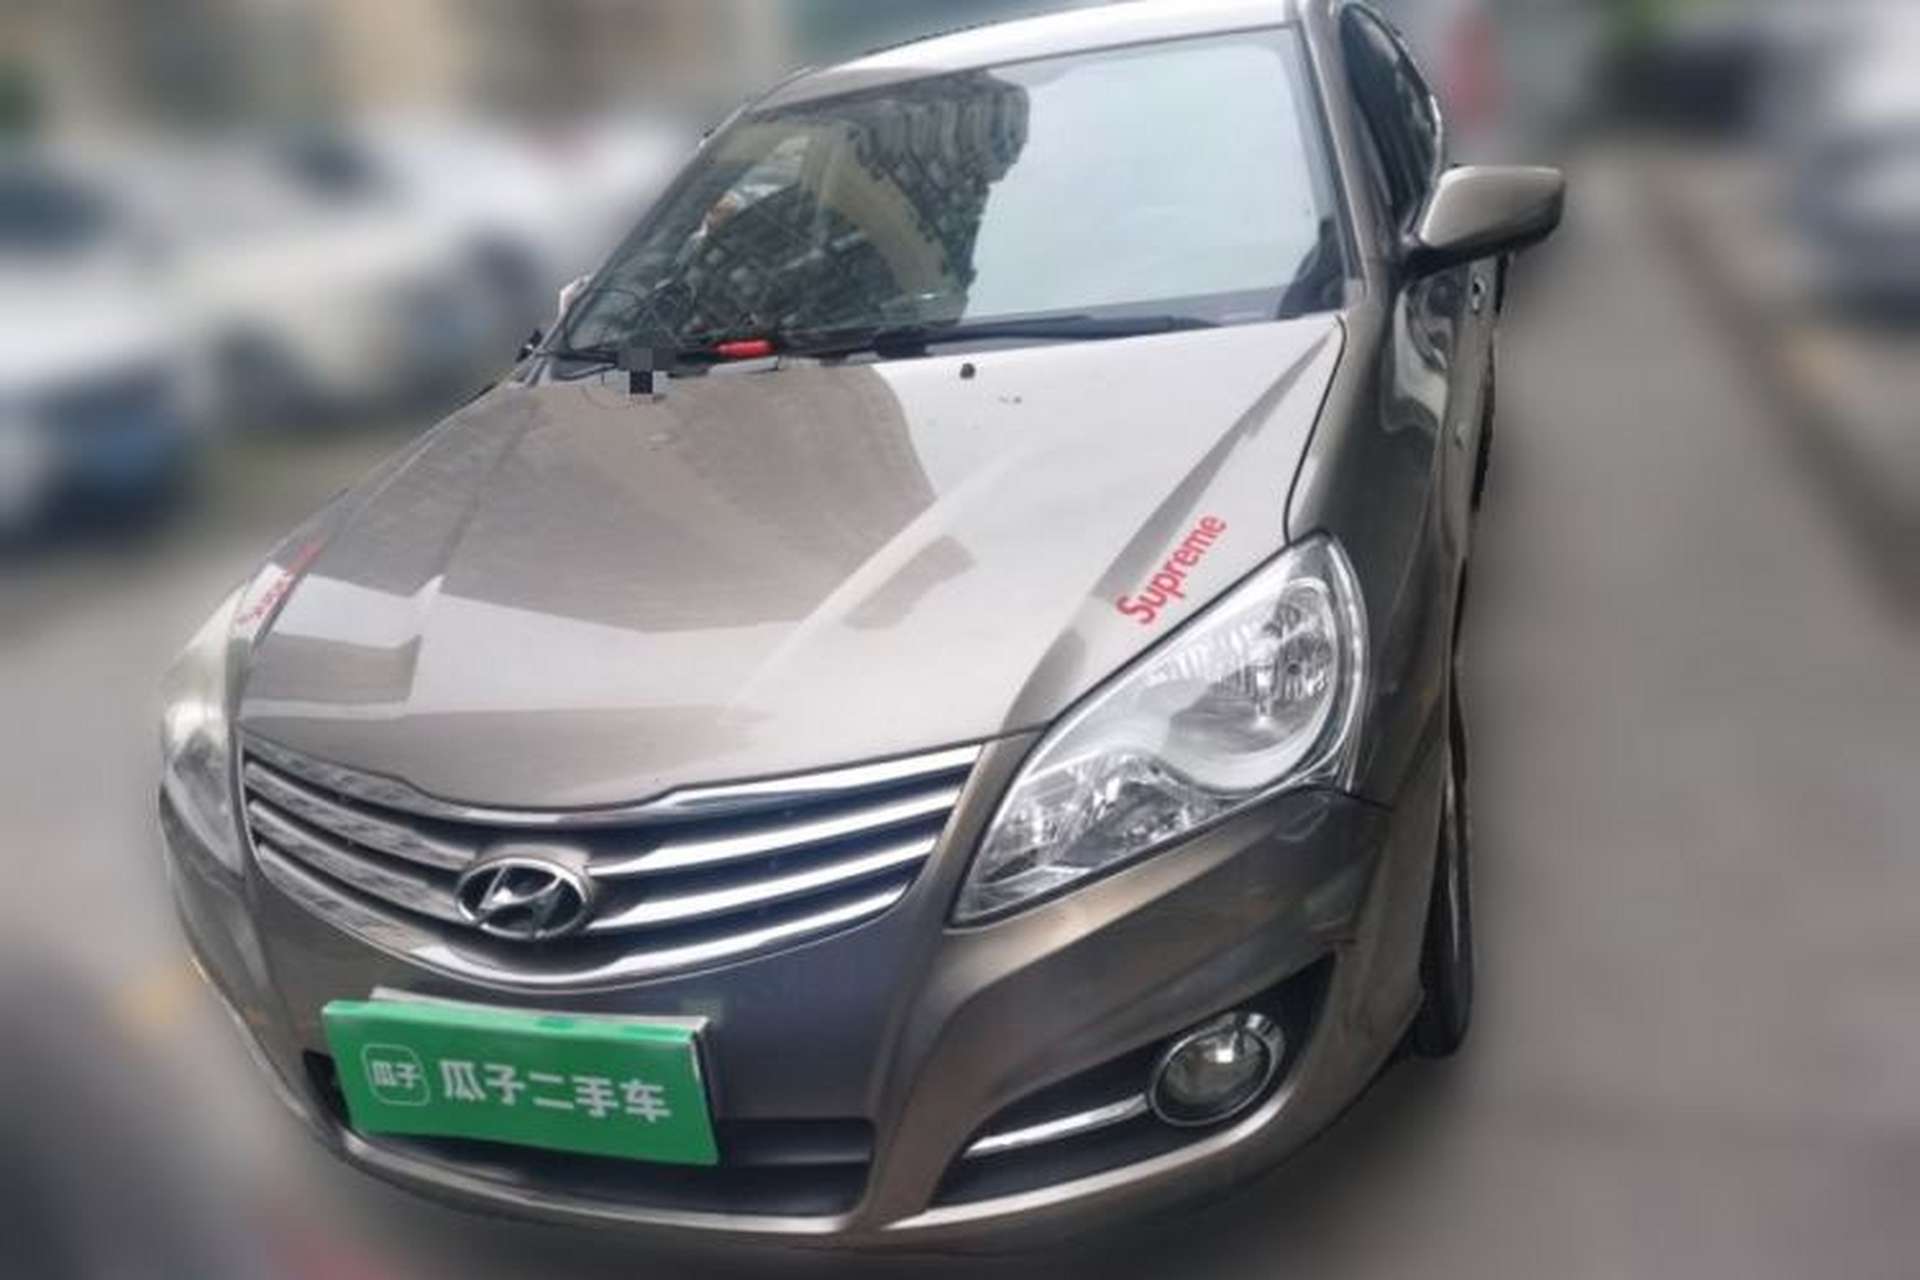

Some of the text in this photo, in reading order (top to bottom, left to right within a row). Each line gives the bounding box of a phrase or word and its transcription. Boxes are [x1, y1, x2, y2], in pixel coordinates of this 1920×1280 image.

[1116, 516, 1226, 625] Supreme
[439, 1058, 672, 1123] 瓜子二手车
